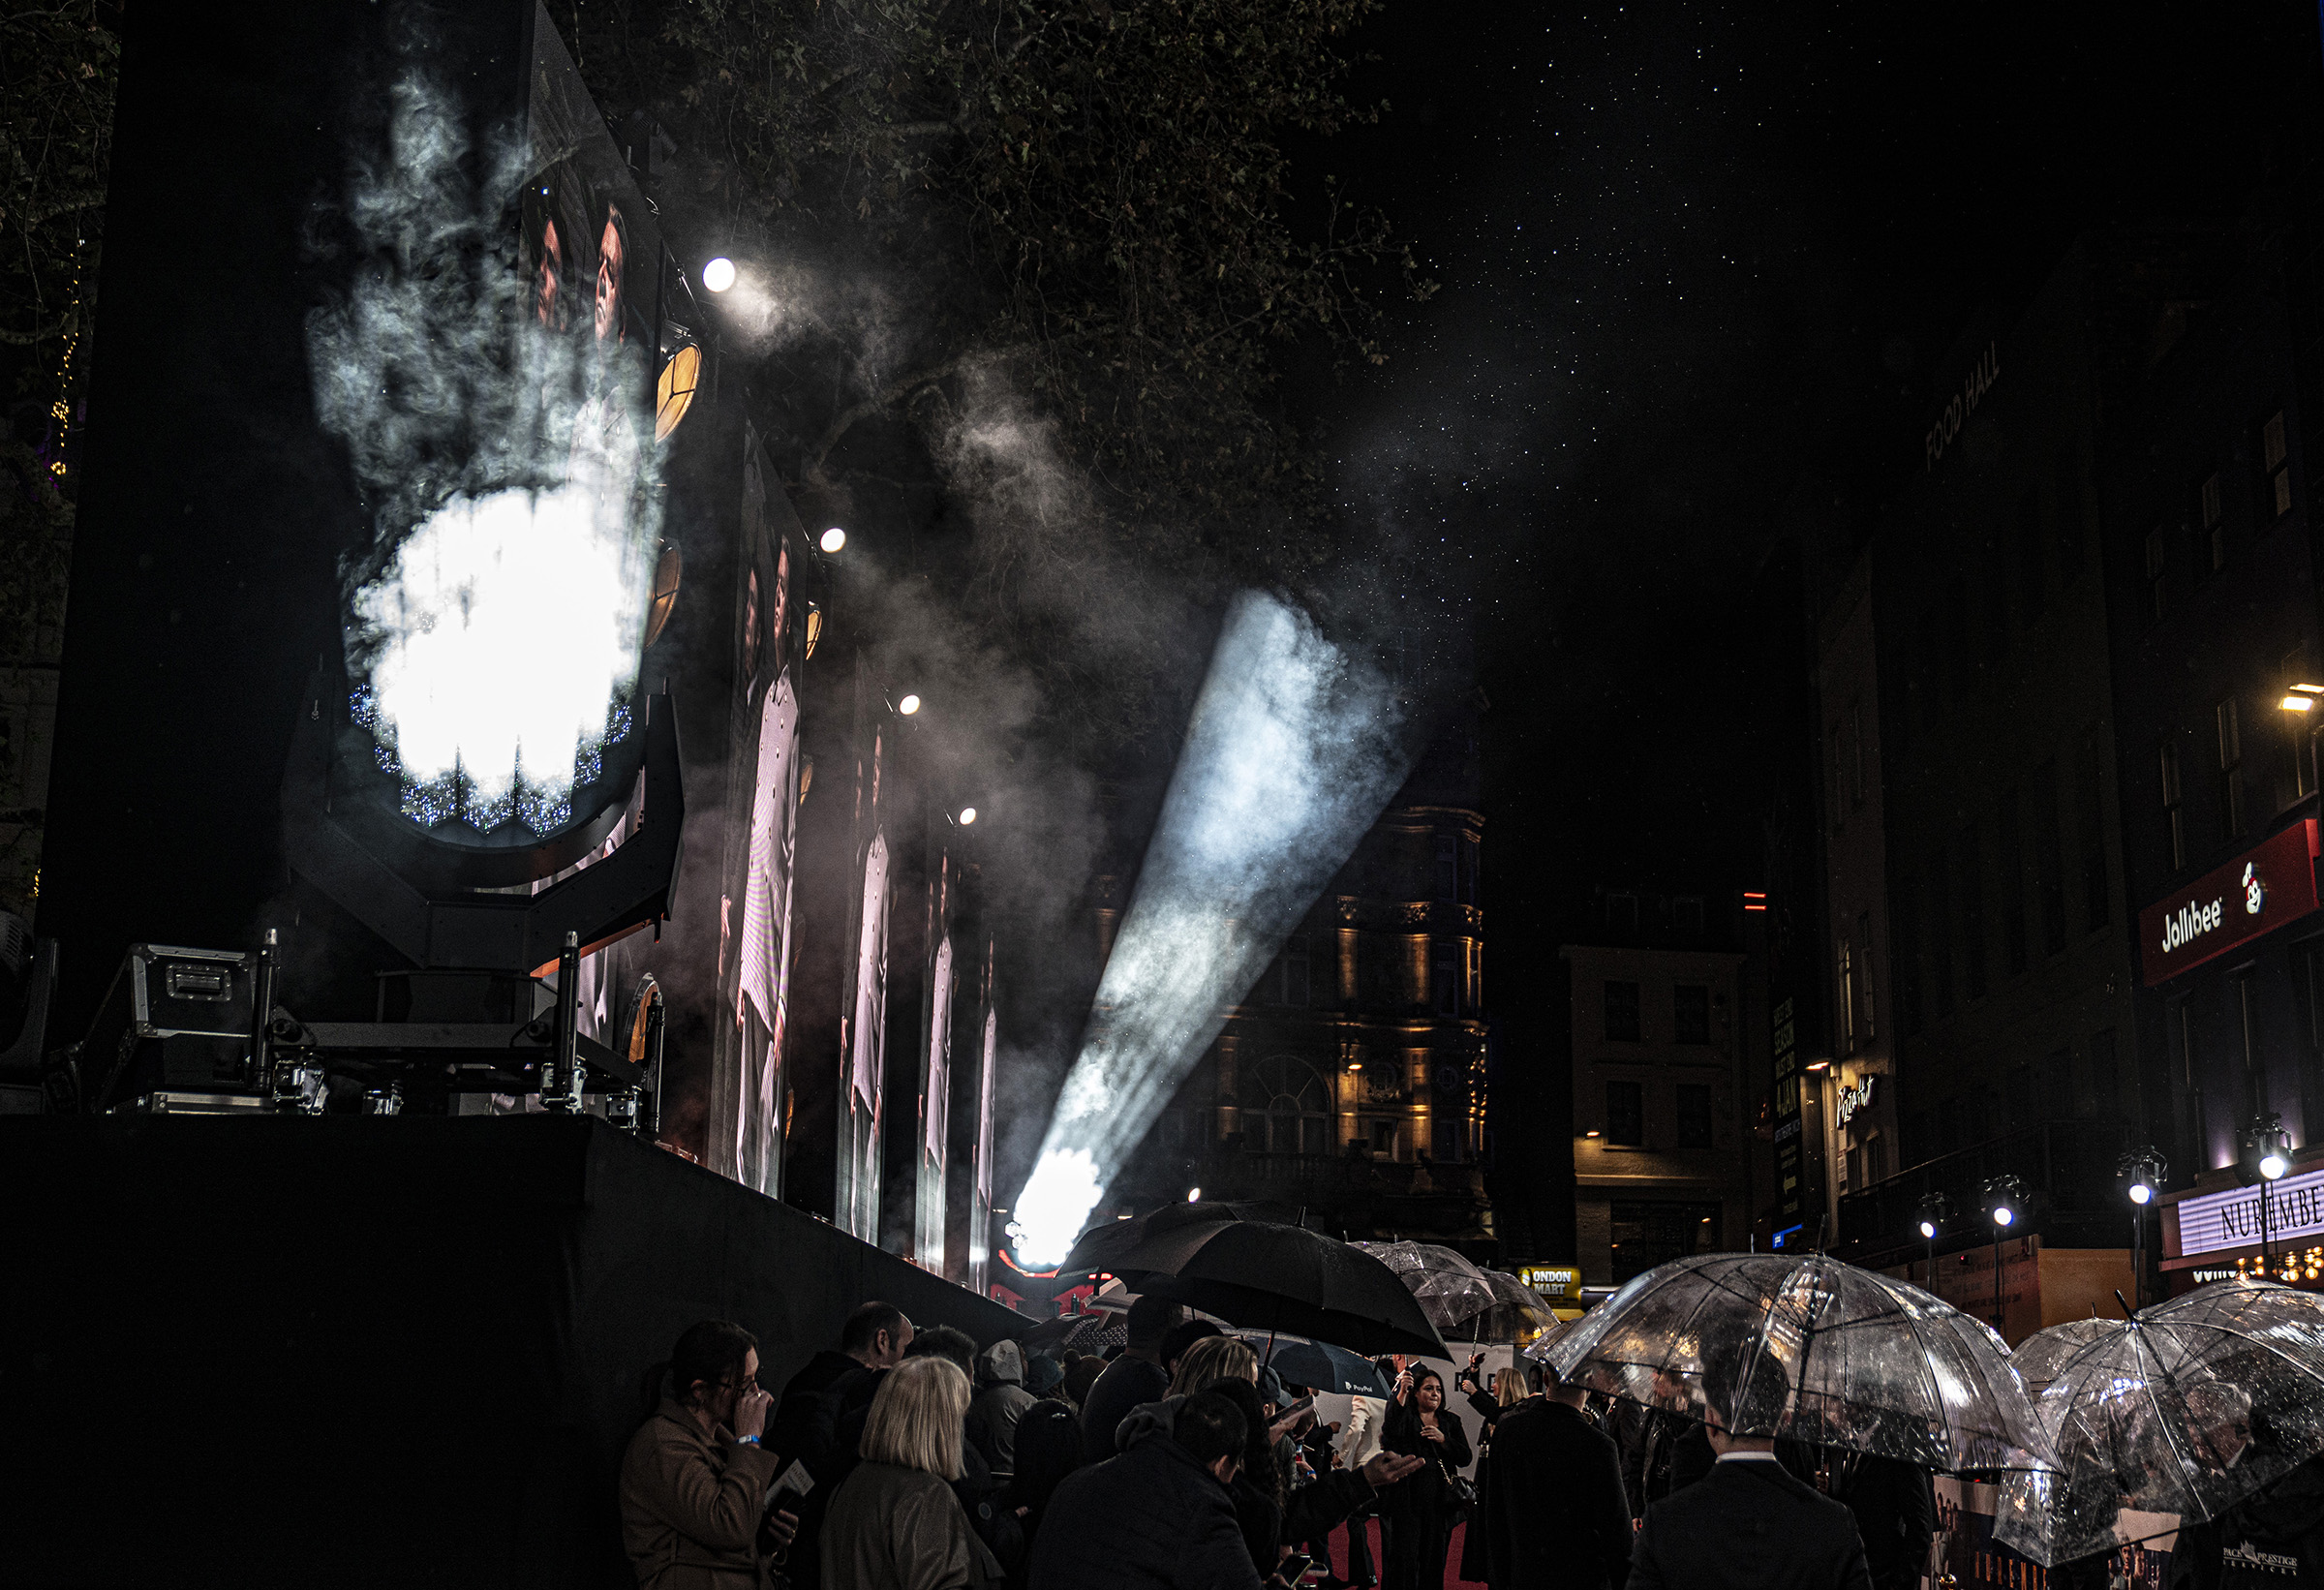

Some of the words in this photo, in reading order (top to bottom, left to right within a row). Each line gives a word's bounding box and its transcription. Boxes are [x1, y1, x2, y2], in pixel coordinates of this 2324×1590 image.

[1925, 394, 1962, 473] FOOD
[1965, 340, 2000, 418] HALL
[2162, 900, 2221, 954] Jollibee
[2221, 1184, 2324, 1239] NUREMBE
[1534, 1283, 1566, 1295] MART
[1353, 1384, 1373, 1392] PayPal
[2257, 1552, 2297, 1567] PRESTIGE
